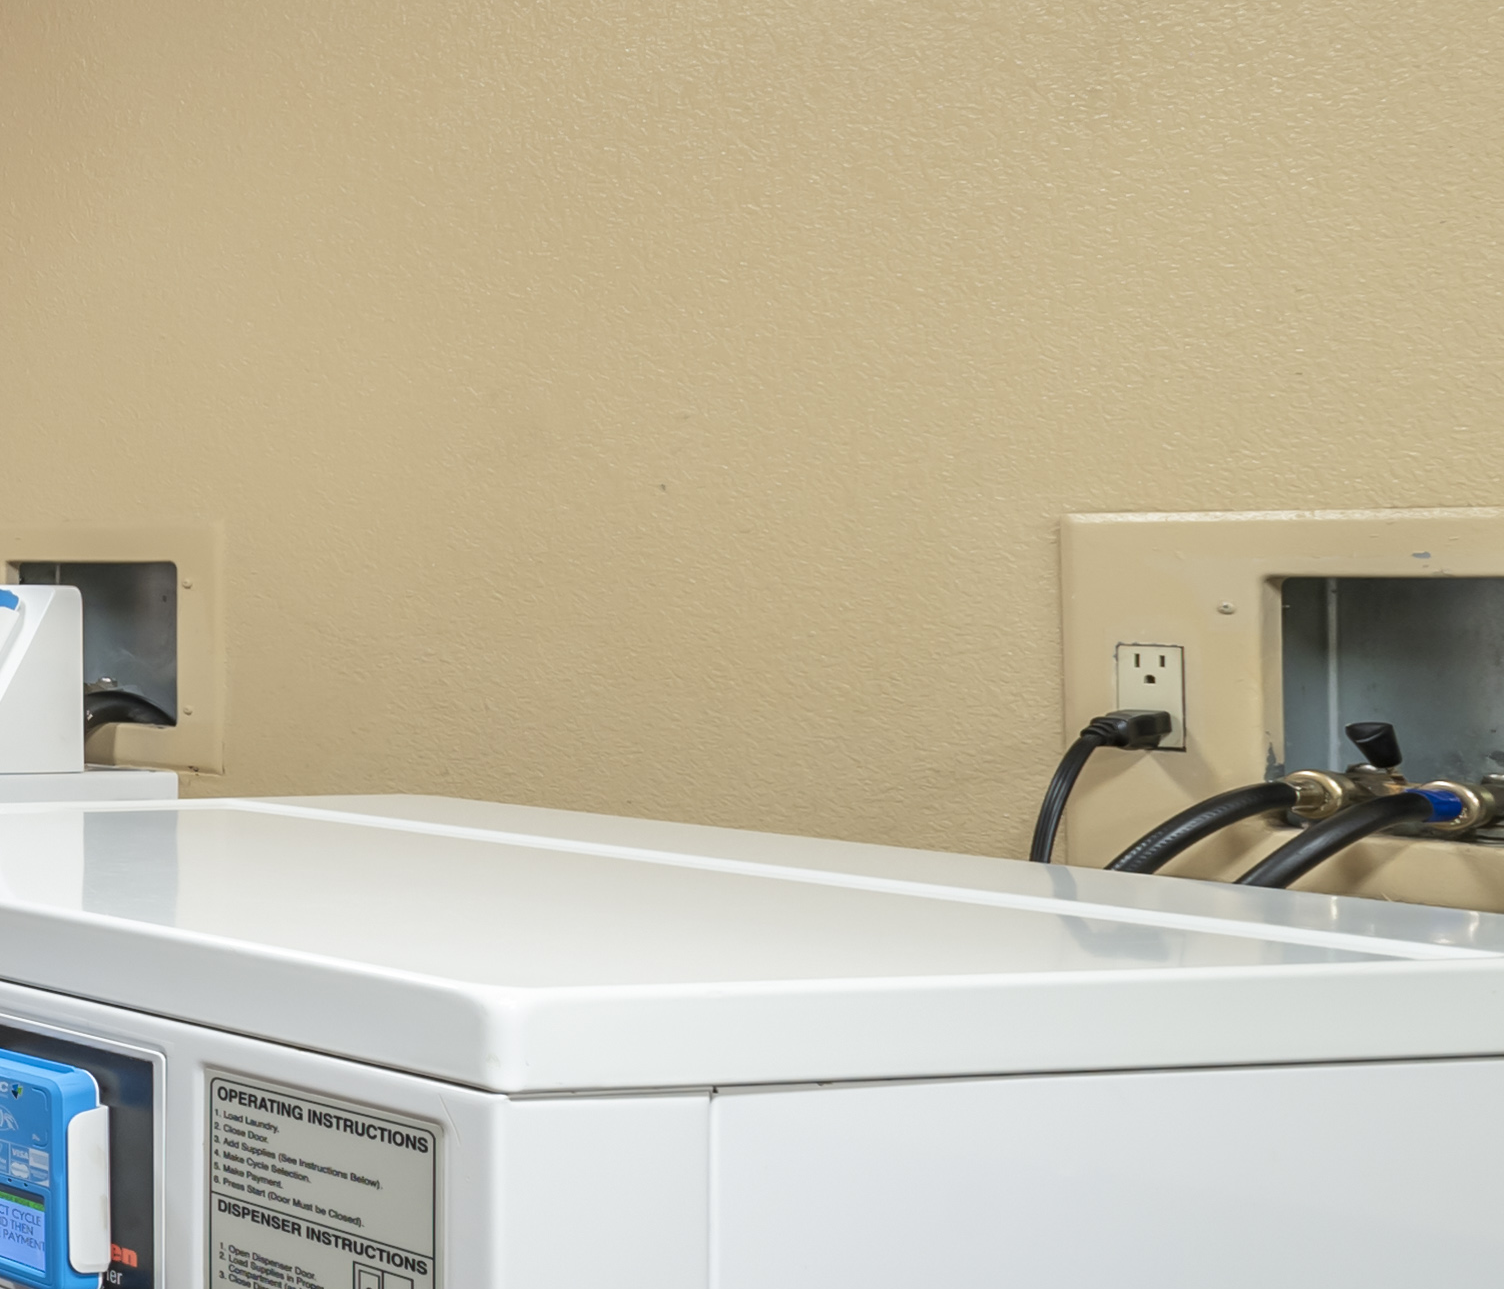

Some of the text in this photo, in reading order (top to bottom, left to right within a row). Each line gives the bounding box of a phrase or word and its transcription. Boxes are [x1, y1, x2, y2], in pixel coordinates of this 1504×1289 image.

[217, 1086, 429, 1154] OPERATING INSTRUCTIONS
[11, 1148, 29, 1160] VISA
[10, 1219, 33, 1236] THEN
[12, 1208, 41, 1227] CYCLE
[3, 1228, 45, 1251] PAYMENT
[218, 1199, 427, 1275] DISPENSER INSTRUCTIONS
[228, 1245, 250, 1259] Open
[252, 1252, 293, 1272] Dispenser
